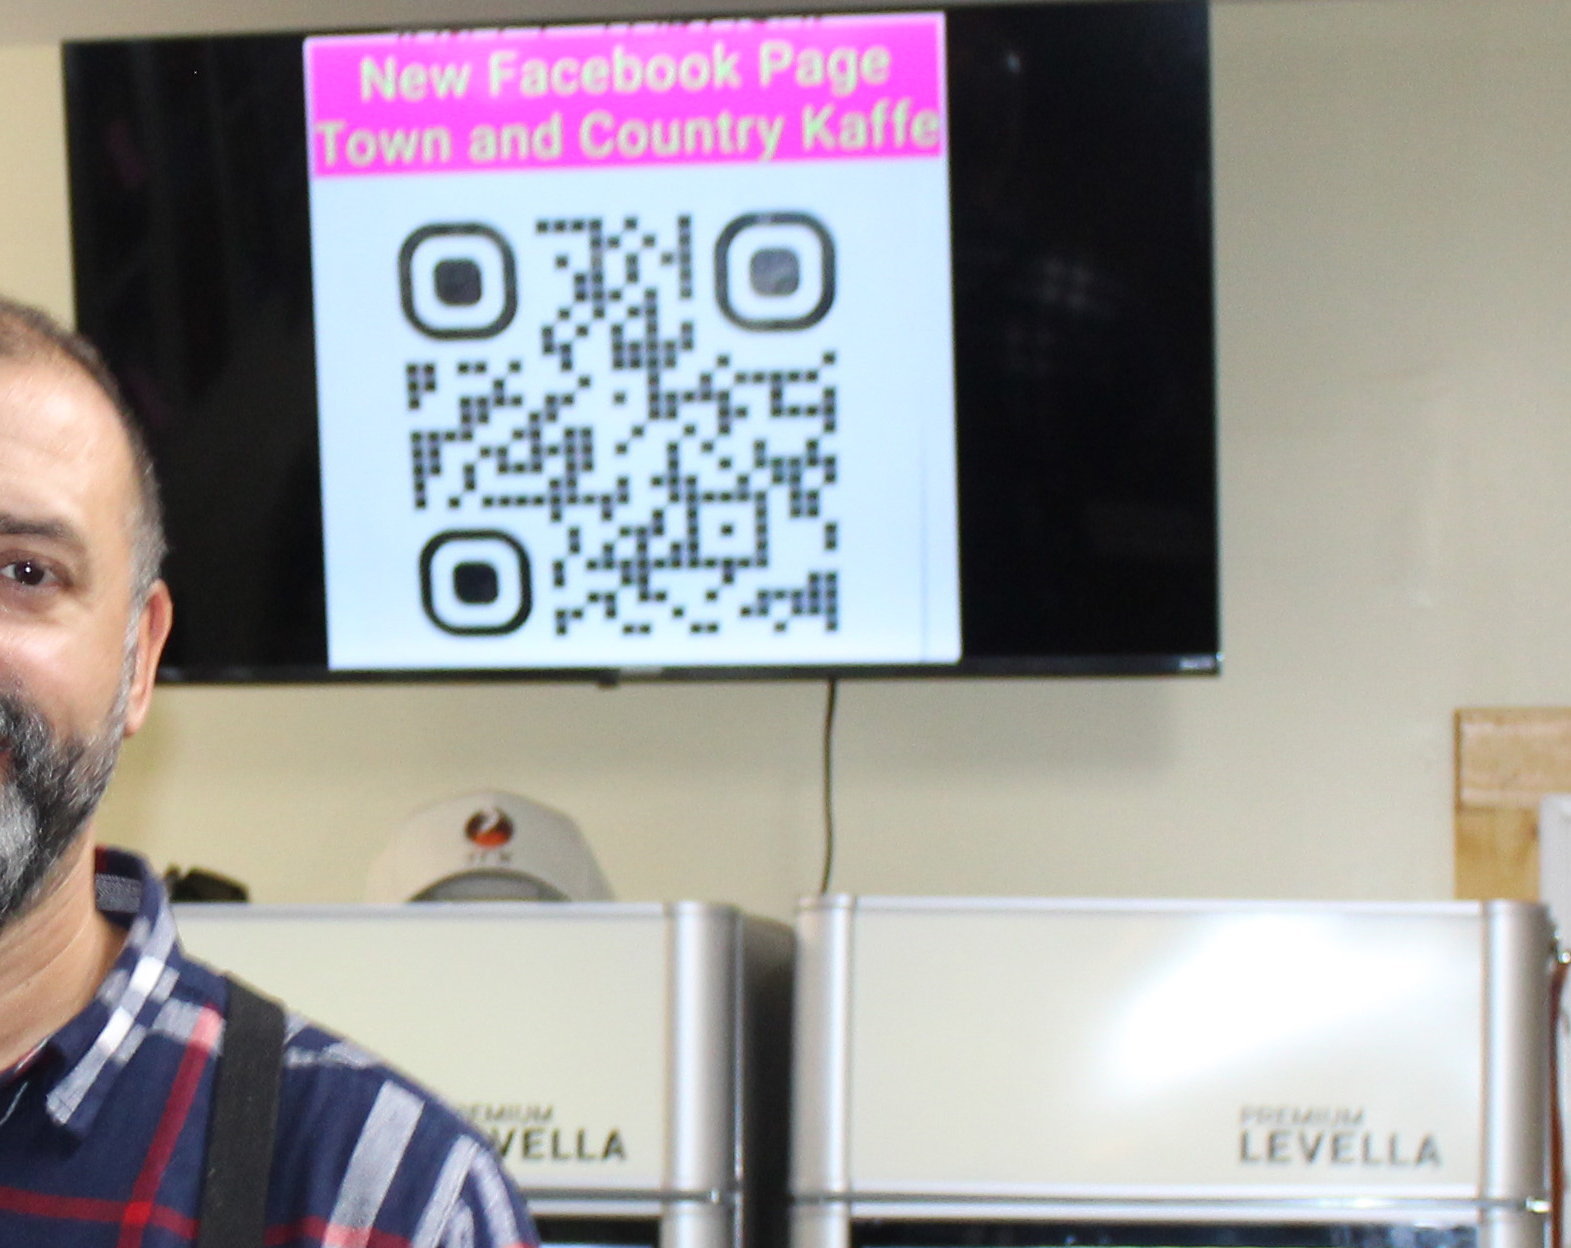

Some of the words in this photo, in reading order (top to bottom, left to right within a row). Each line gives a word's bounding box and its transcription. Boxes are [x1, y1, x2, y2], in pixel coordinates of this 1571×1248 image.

[359, 55, 471, 102] New
[488, 41, 743, 98] Facebook
[758, 39, 891, 96] Page
[317, 117, 452, 168] Town
[468, 111, 563, 163] and
[579, 108, 785, 162] Country
[802, 96, 941, 151] Kaffe
[1238, 1129, 1442, 1168] LEVELLA
